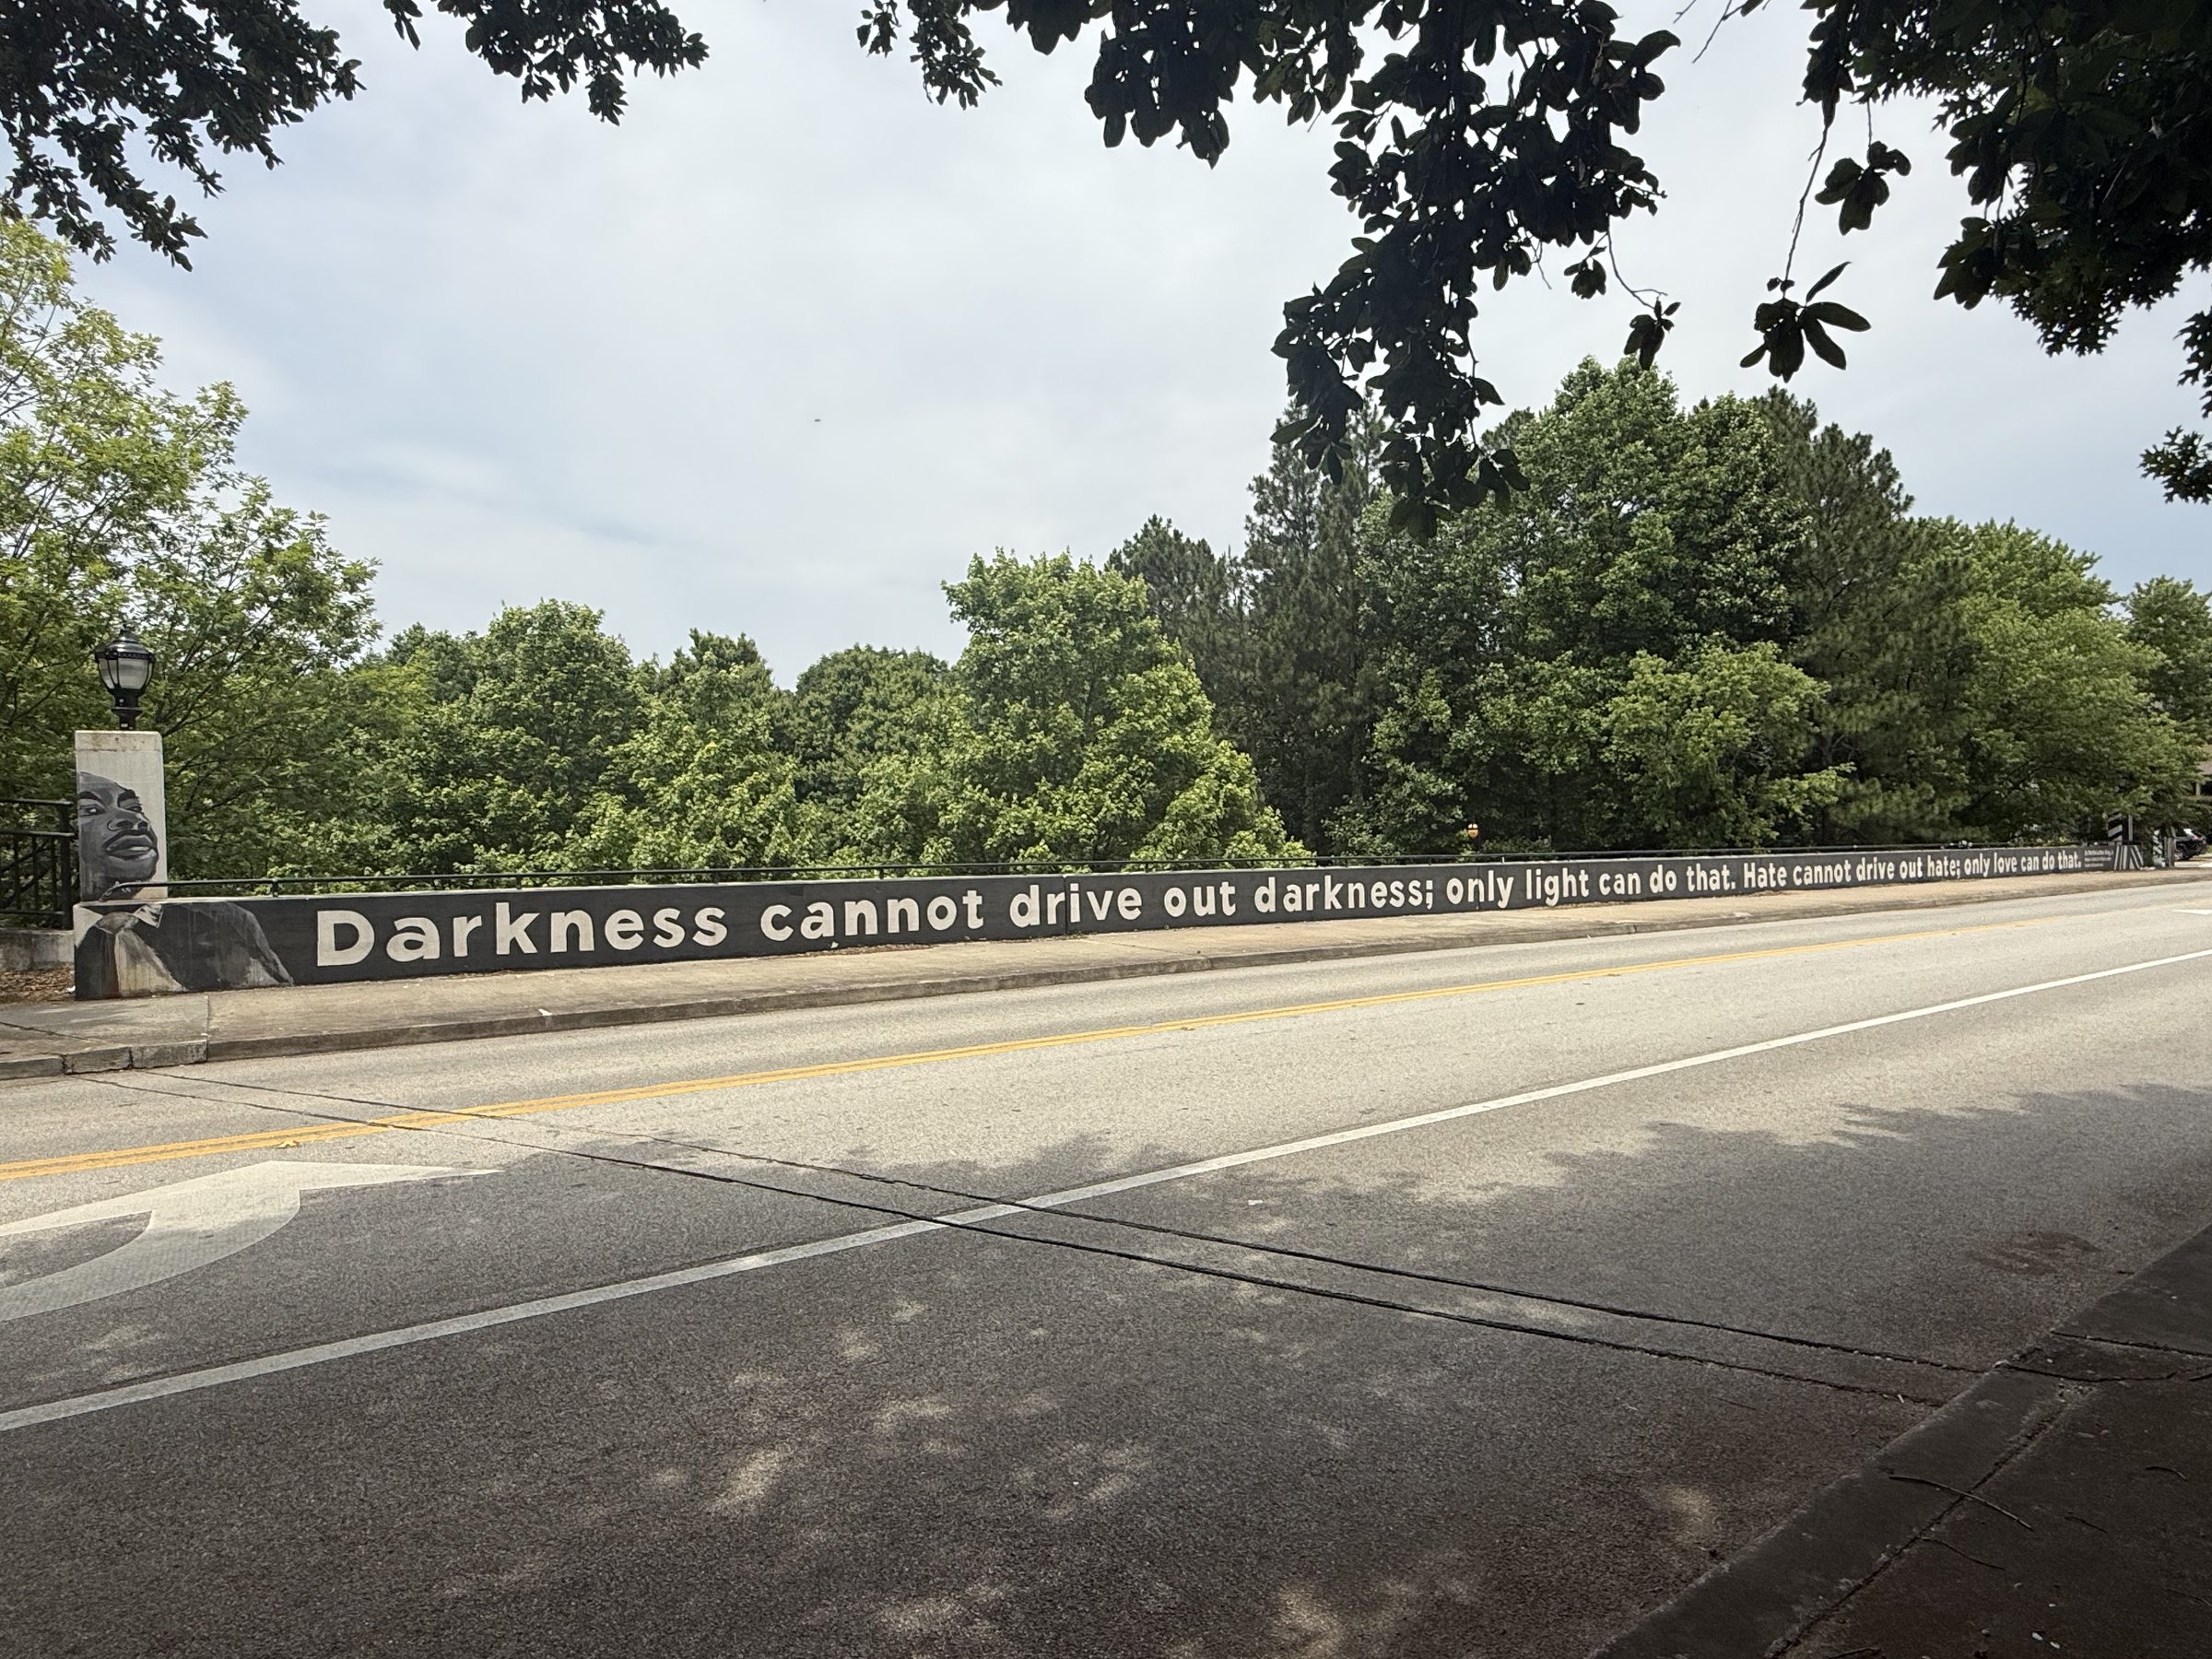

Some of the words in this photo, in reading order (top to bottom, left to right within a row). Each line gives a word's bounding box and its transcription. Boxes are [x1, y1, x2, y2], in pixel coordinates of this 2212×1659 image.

[316, 901, 728, 967] Darkness
[760, 889, 984, 941] cannot
[1010, 883, 1142, 927] drive
[1164, 882, 1235, 917] out
[1254, 876, 1434, 911] darkness;
[1447, 870, 1513, 908] only
[1526, 867, 1589, 906] light
[1599, 873, 1641, 895] can
[1650, 865, 1677, 893] do
[1687, 864, 1735, 891] that.
[1744, 863, 1787, 888] Hate
[1793, 860, 1851, 886] cannot
[1856, 857, 1895, 881] drive
[1900, 857, 1923, 879] out
[1927, 855, 1960, 878] hate;
[1964, 853, 1990, 877] only
[1994, 853, 2018, 873] love
[2021, 856, 2039, 872] can
[2042, 851, 2054, 870] do
[2058, 850, 2081, 869] that.
